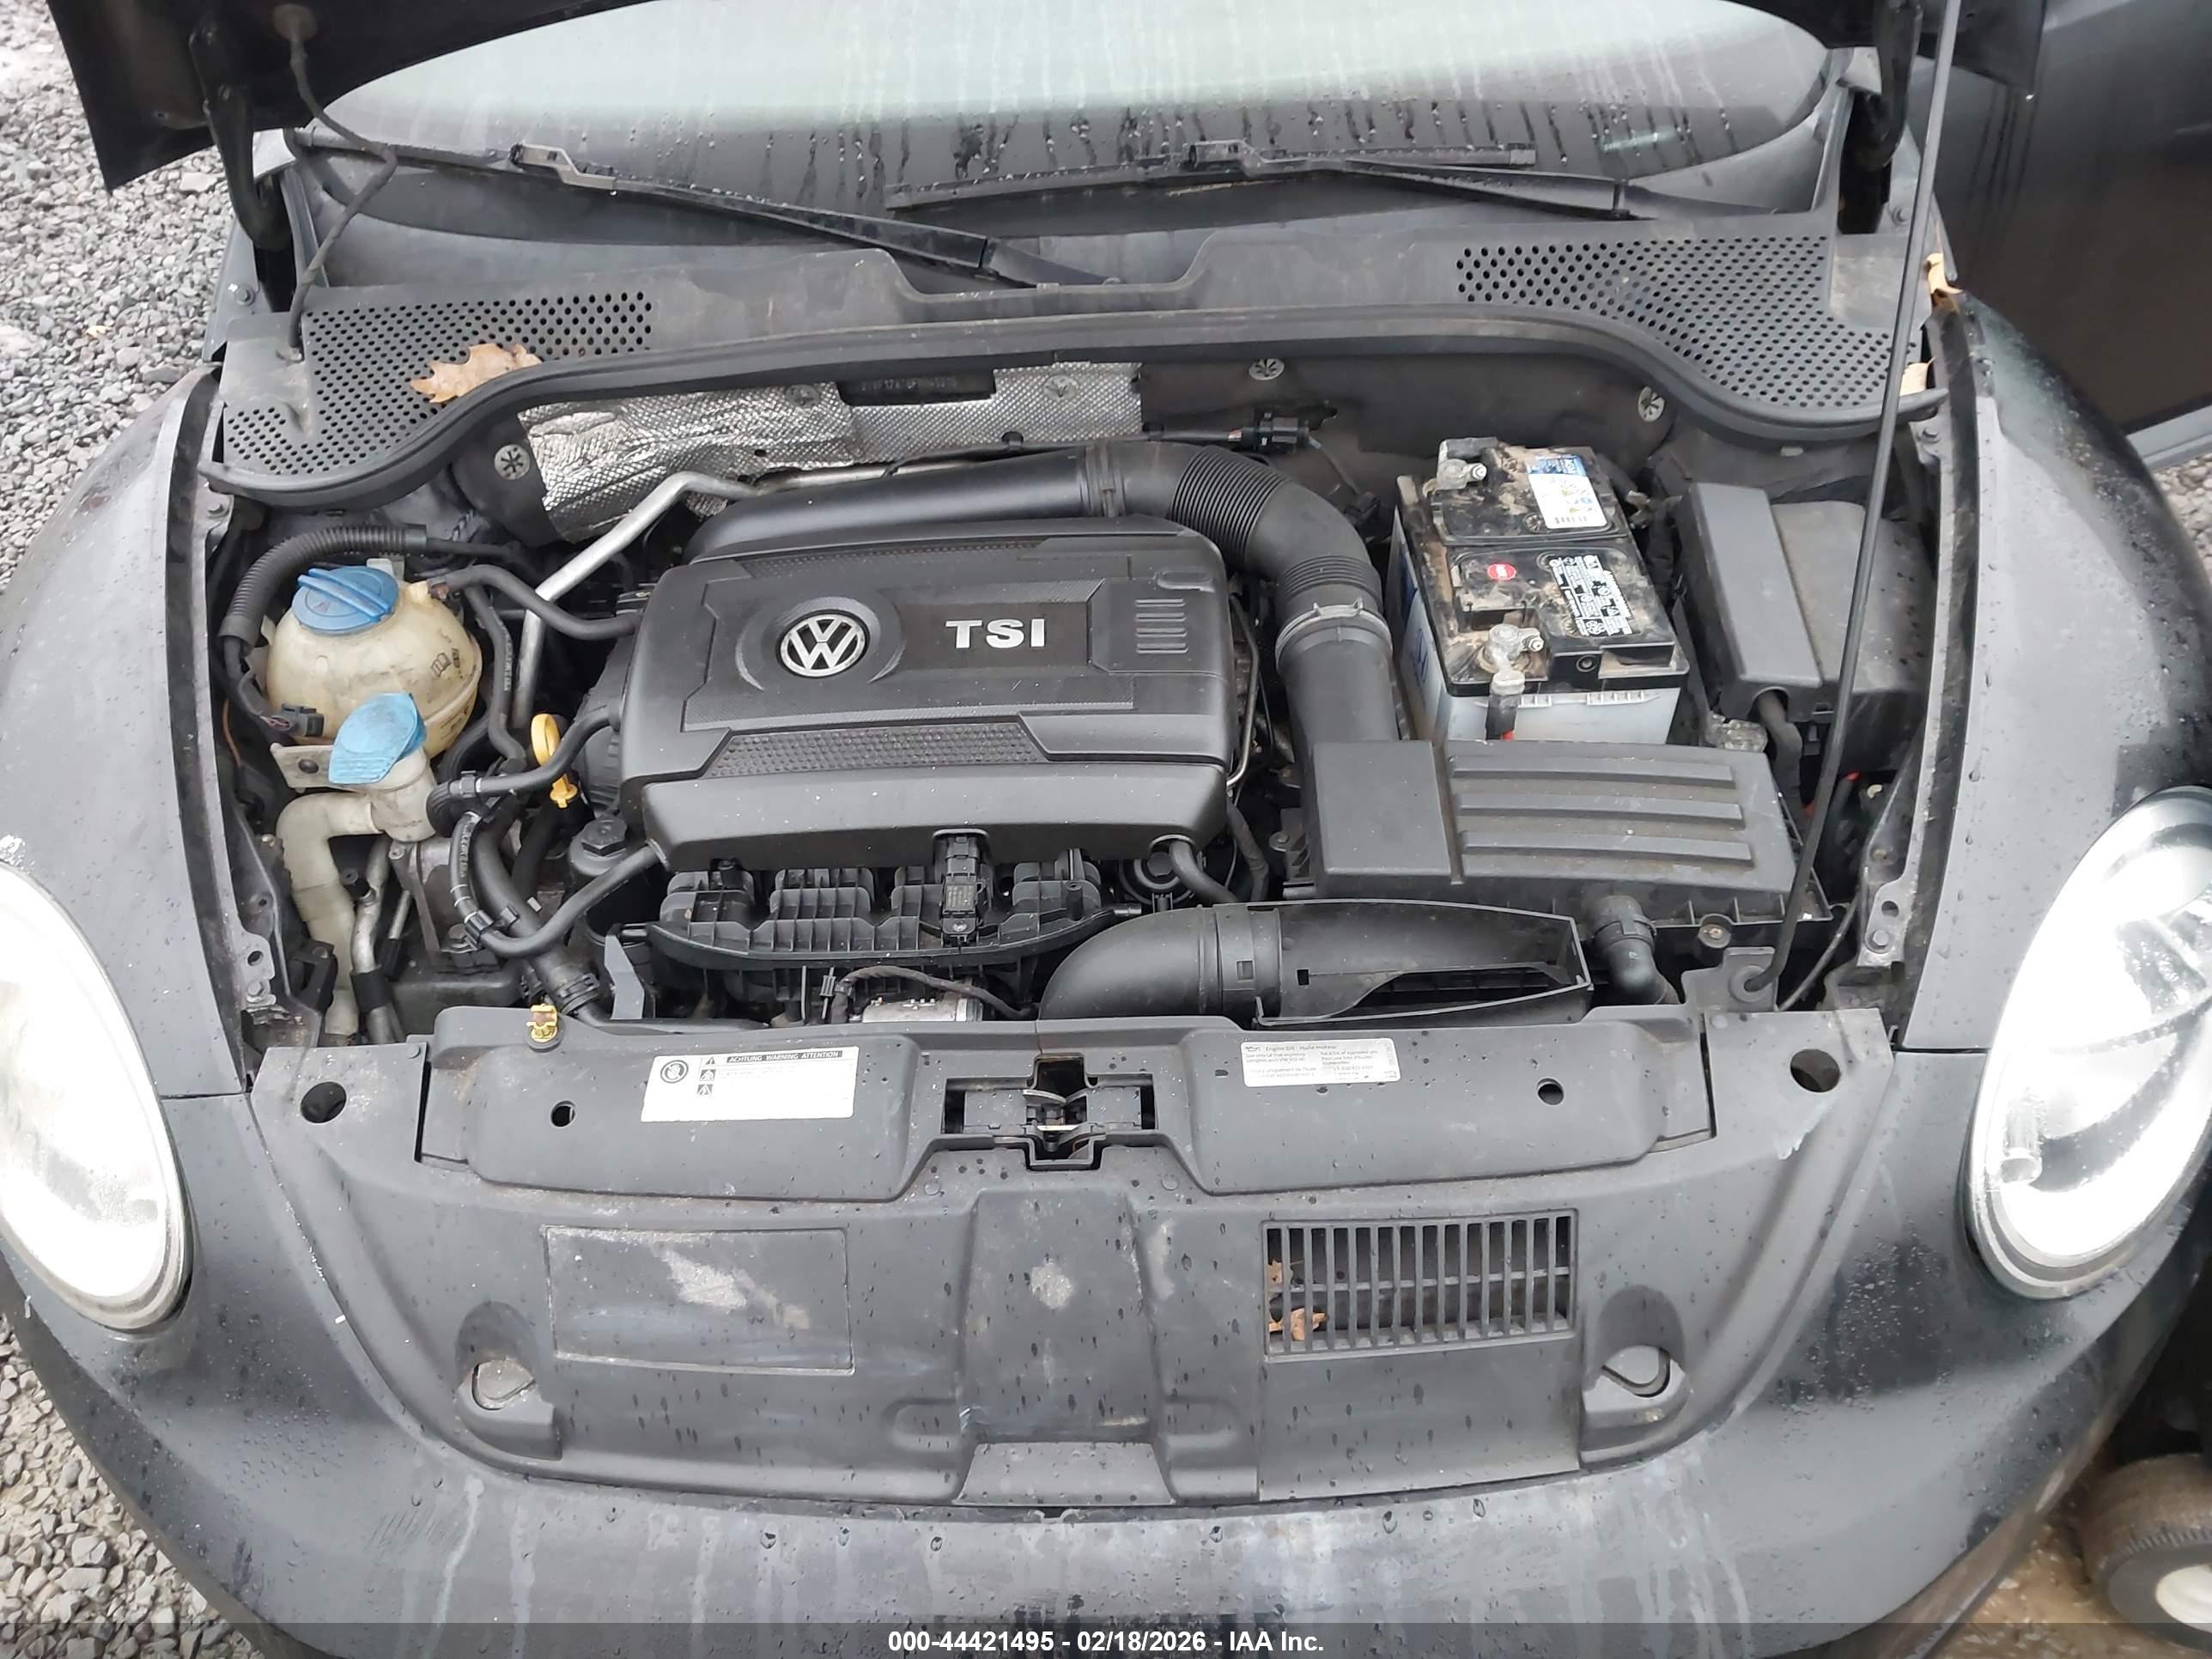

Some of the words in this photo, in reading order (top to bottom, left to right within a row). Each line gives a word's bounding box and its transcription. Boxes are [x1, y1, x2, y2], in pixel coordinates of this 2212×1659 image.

[945, 618, 1045, 649] TSI
[765, 1053, 799, 1061] WARNING
[800, 1051, 839, 1060] ATTENTION
